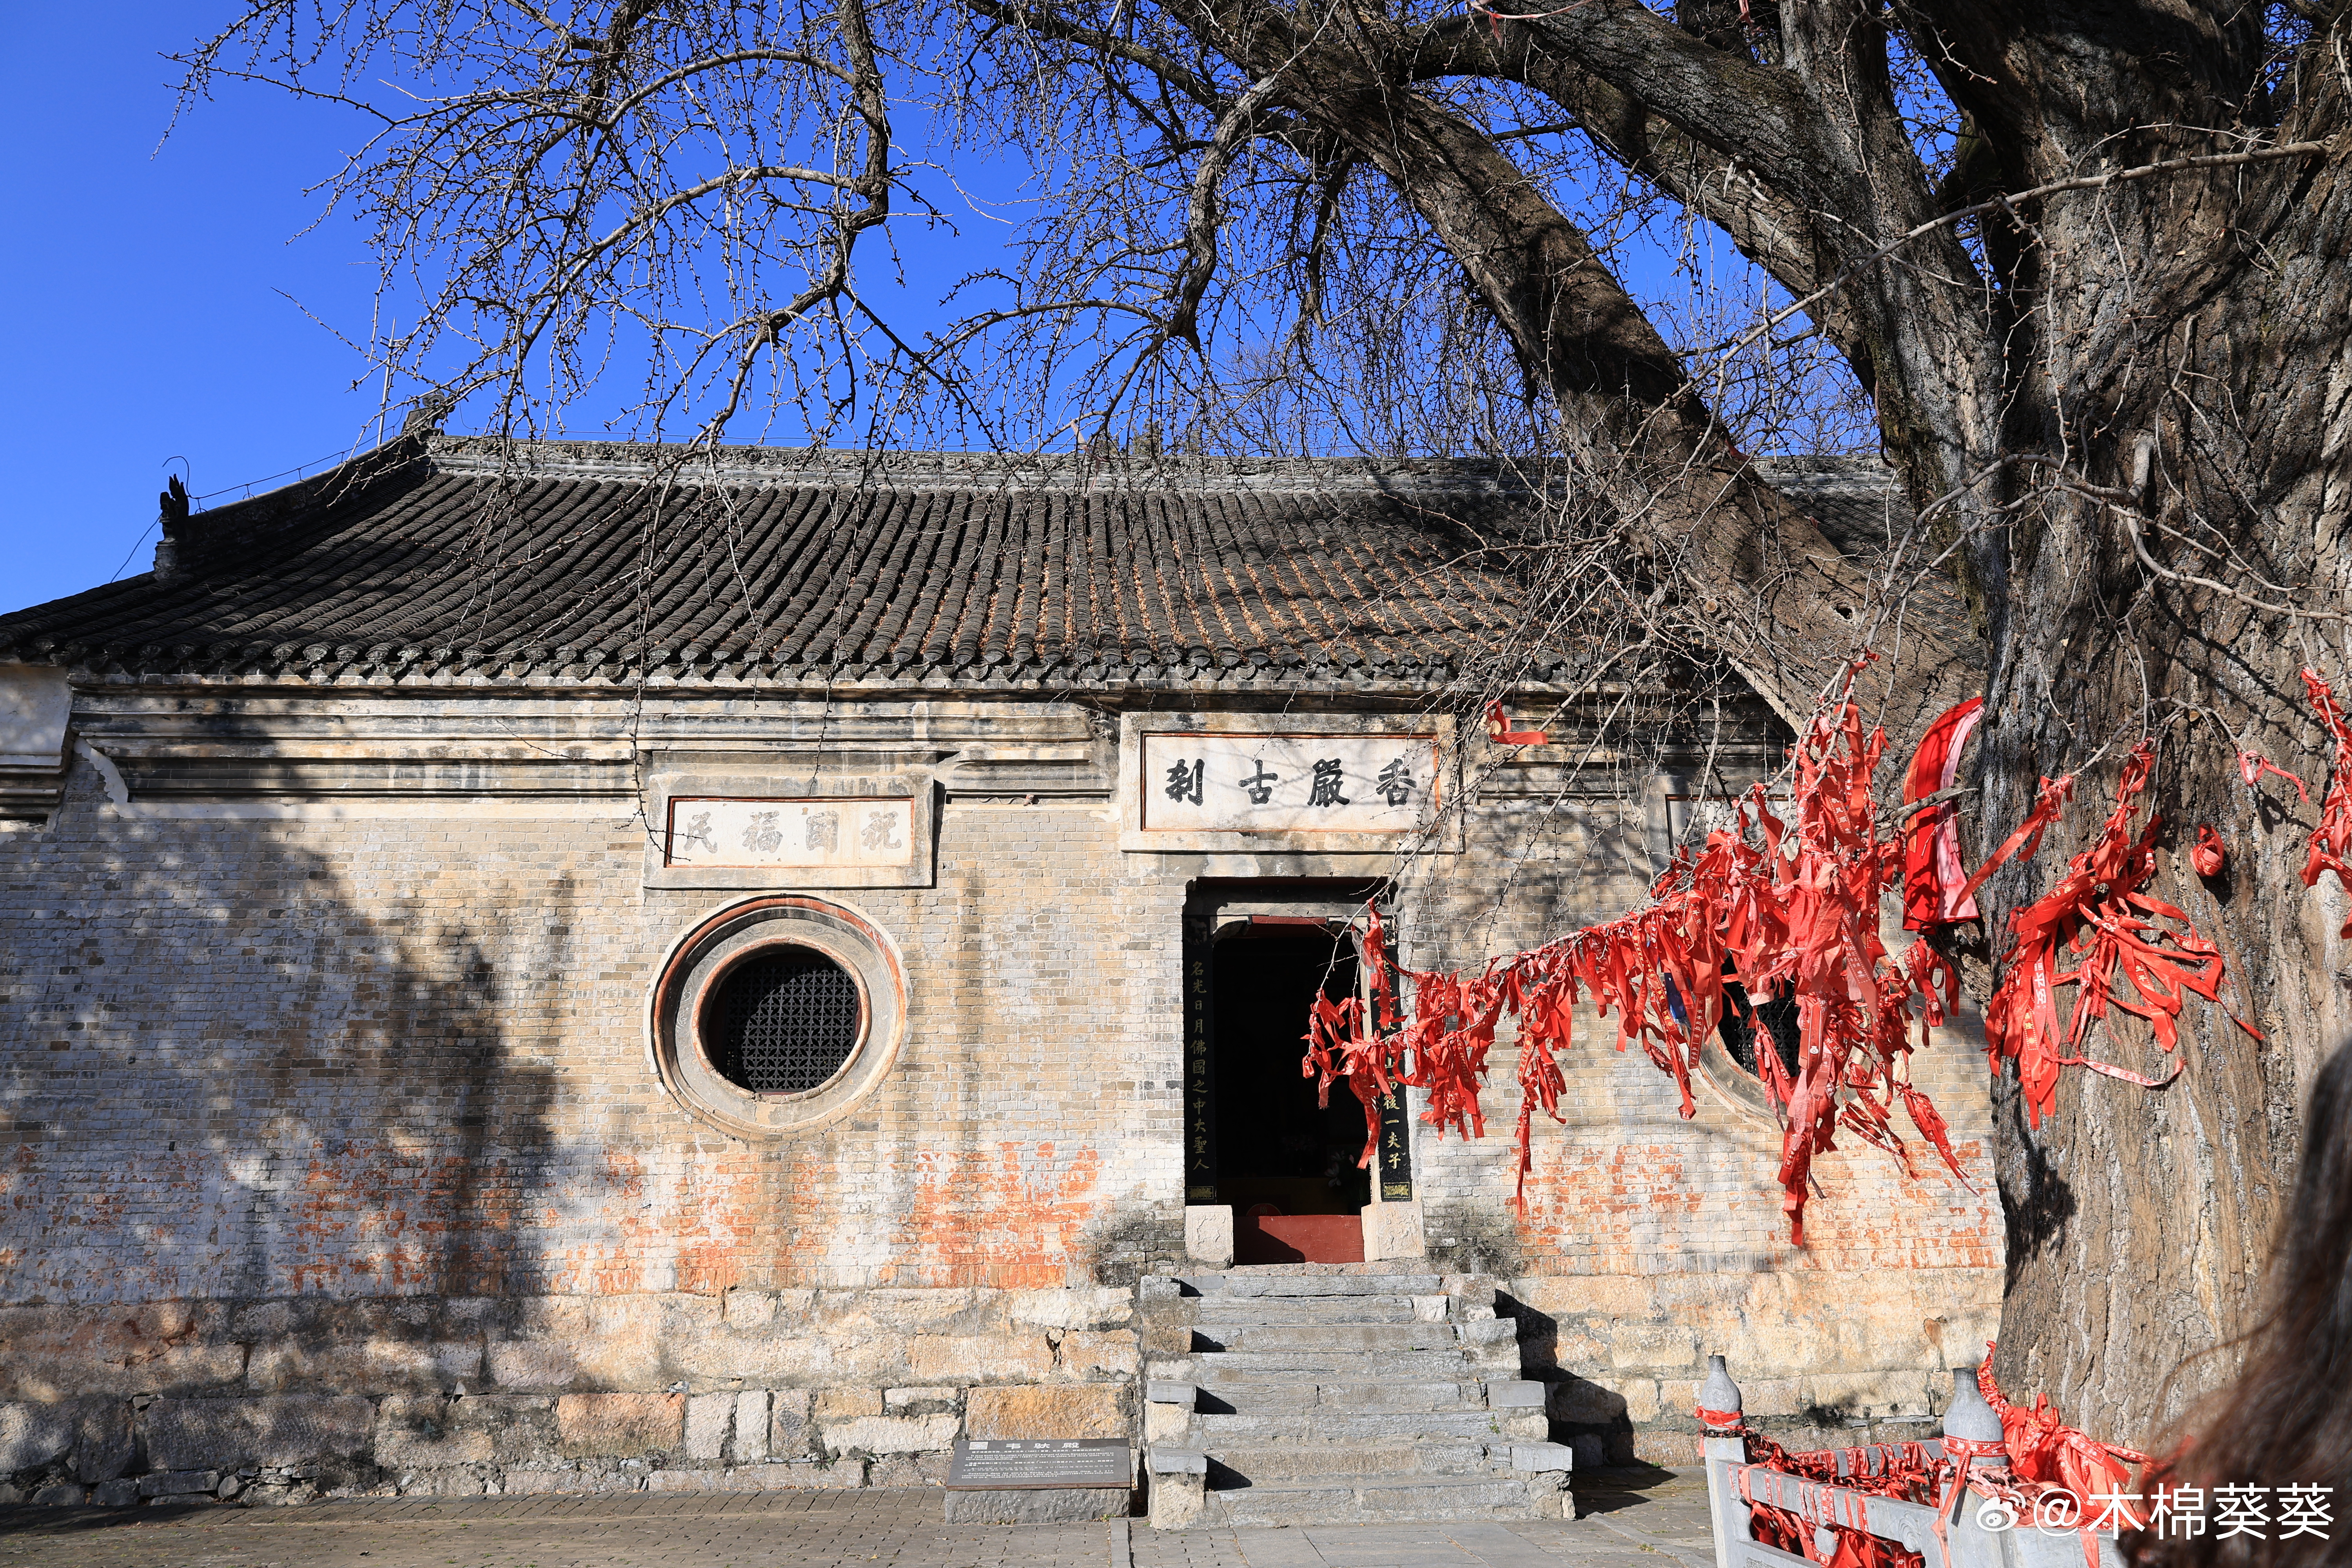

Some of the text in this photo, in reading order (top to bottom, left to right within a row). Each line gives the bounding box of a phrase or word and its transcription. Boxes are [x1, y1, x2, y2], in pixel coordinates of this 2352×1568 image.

[1189, 960, 1210, 1171] 名光日月佛國之中大聖人
